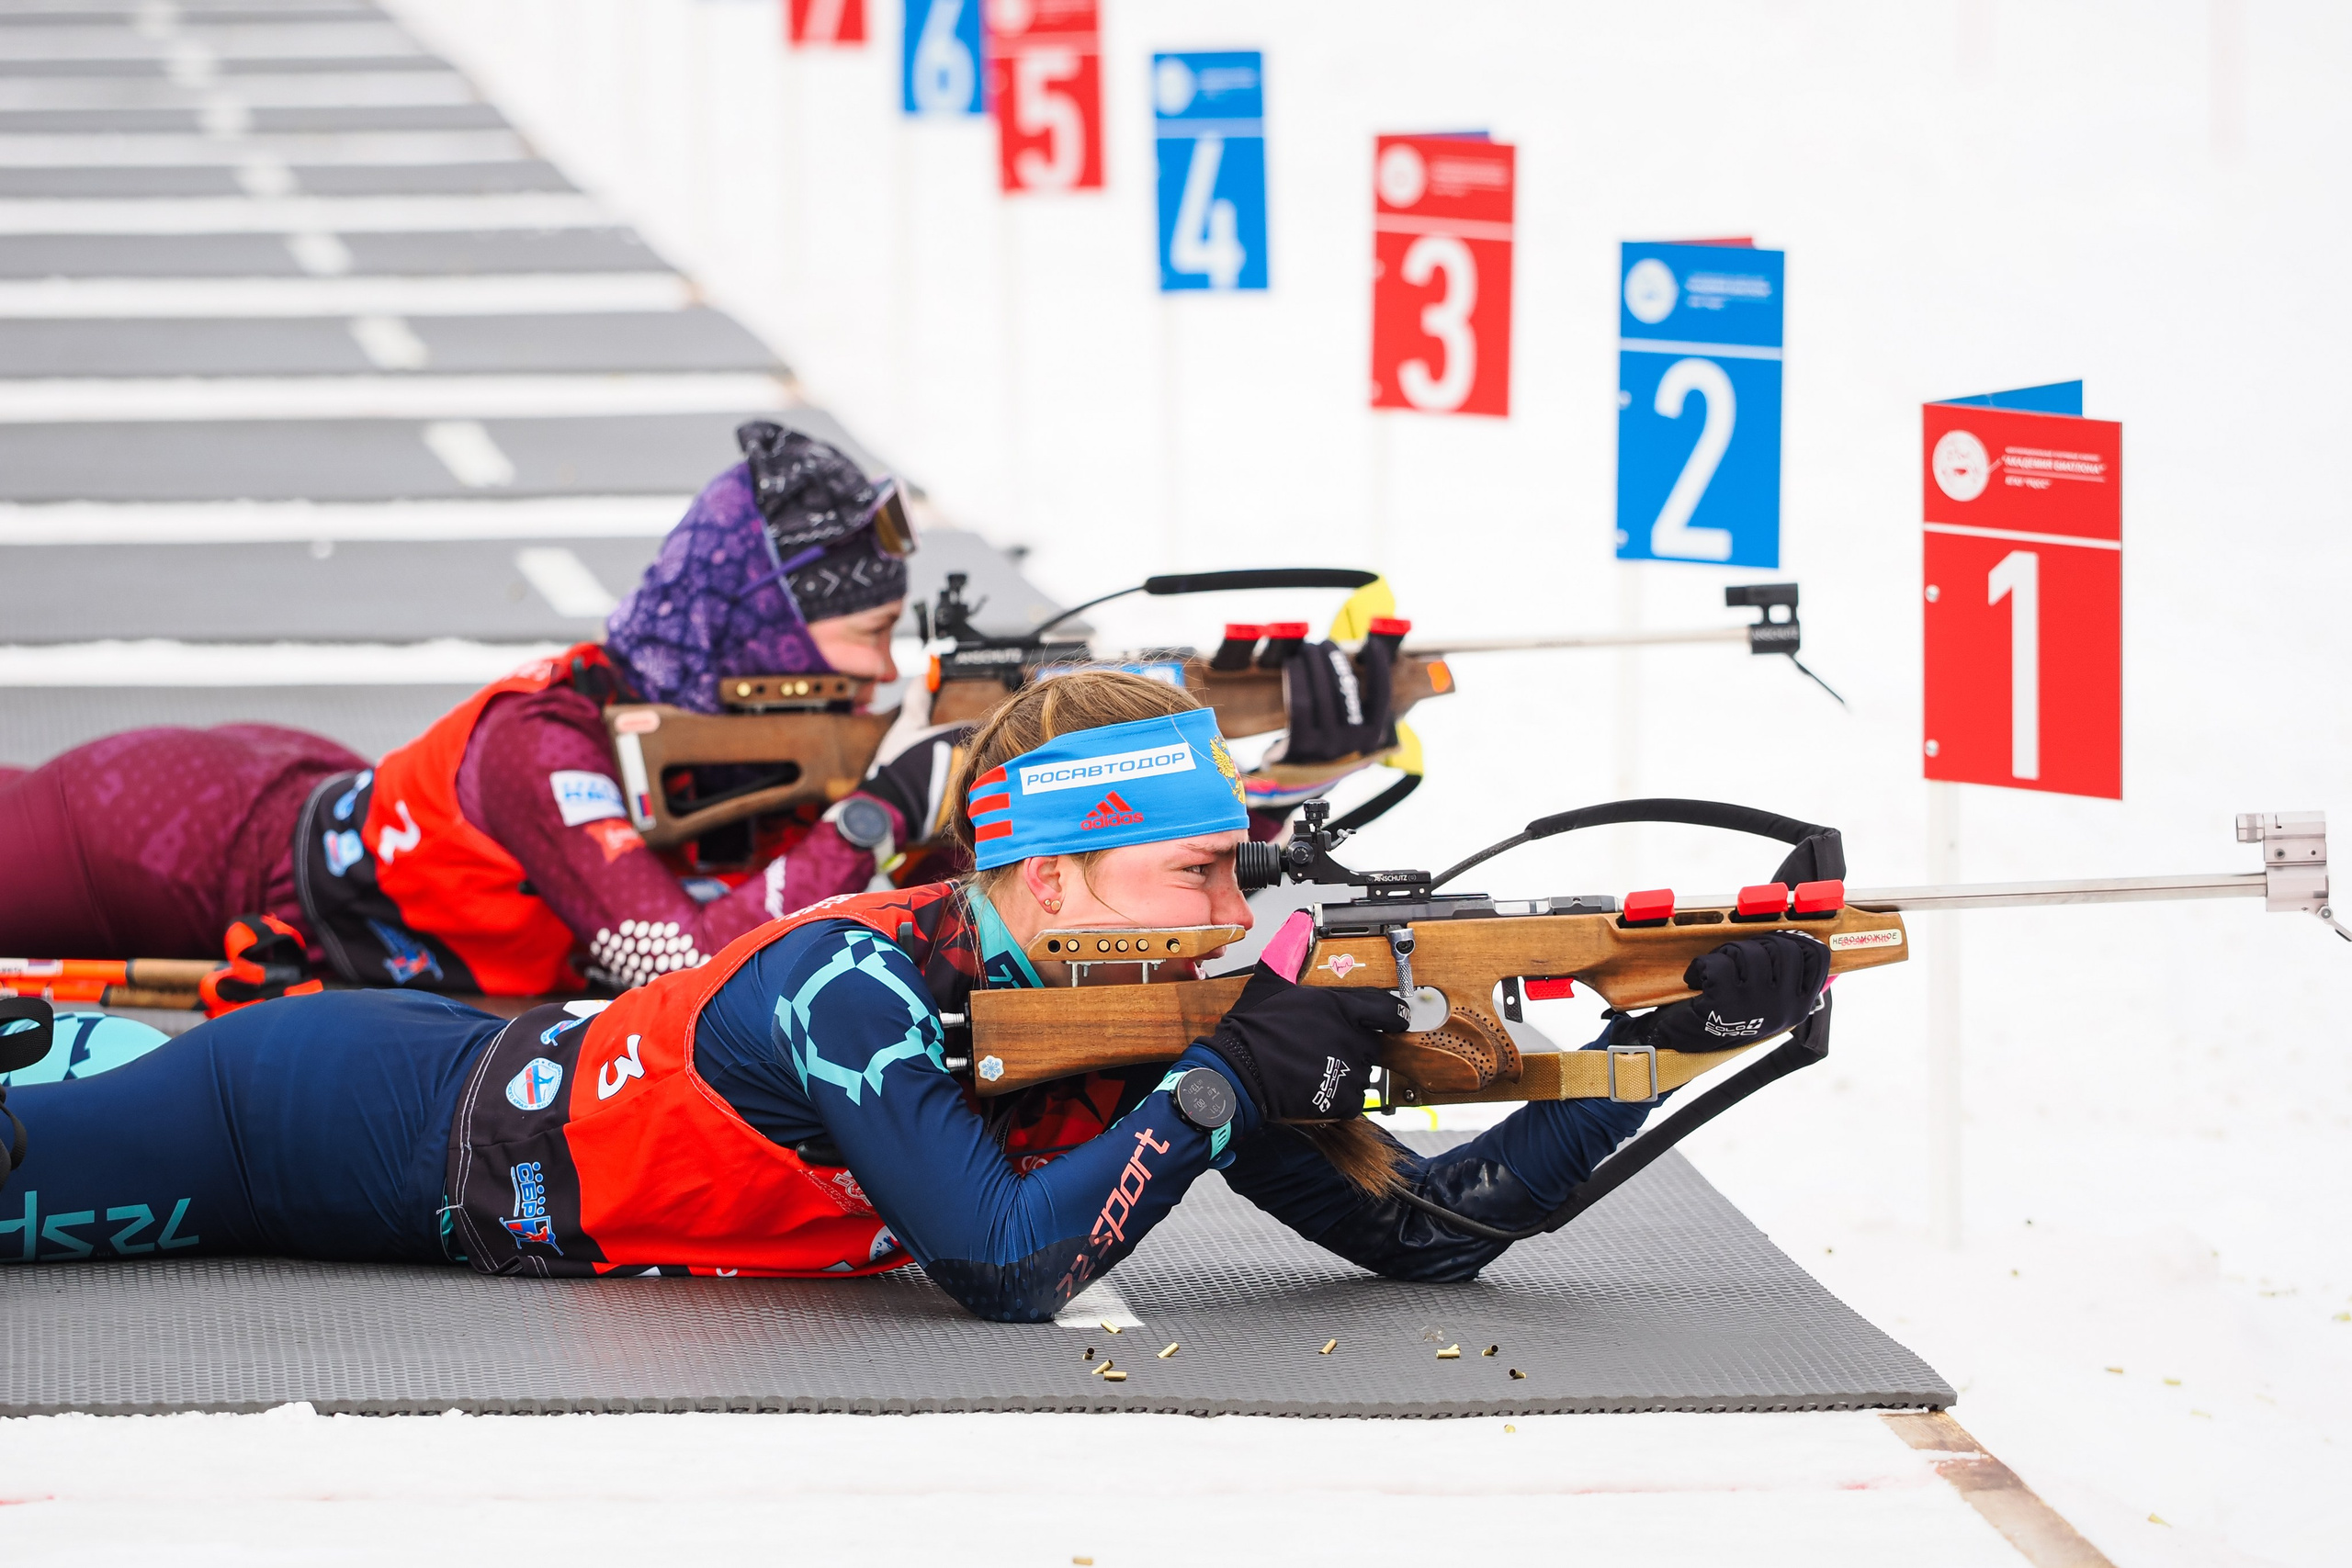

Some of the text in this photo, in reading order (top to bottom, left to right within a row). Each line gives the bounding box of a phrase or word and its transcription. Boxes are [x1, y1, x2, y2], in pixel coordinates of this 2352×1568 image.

[914, 0, 975, 114] 6
[1015, 50, 1086, 191] 5
[1170, 131, 1246, 289] 4
[1397, 231, 1477, 412] 3
[1652, 357, 1736, 561] 2
[1988, 550, 2041, 781] 1
[1026, 751, 1186, 787] РОСАВТОДОР
[1080, 810, 1144, 831] adidas
[597, 1033, 646, 1101] 3
[1088, 1128, 1170, 1247] sport
